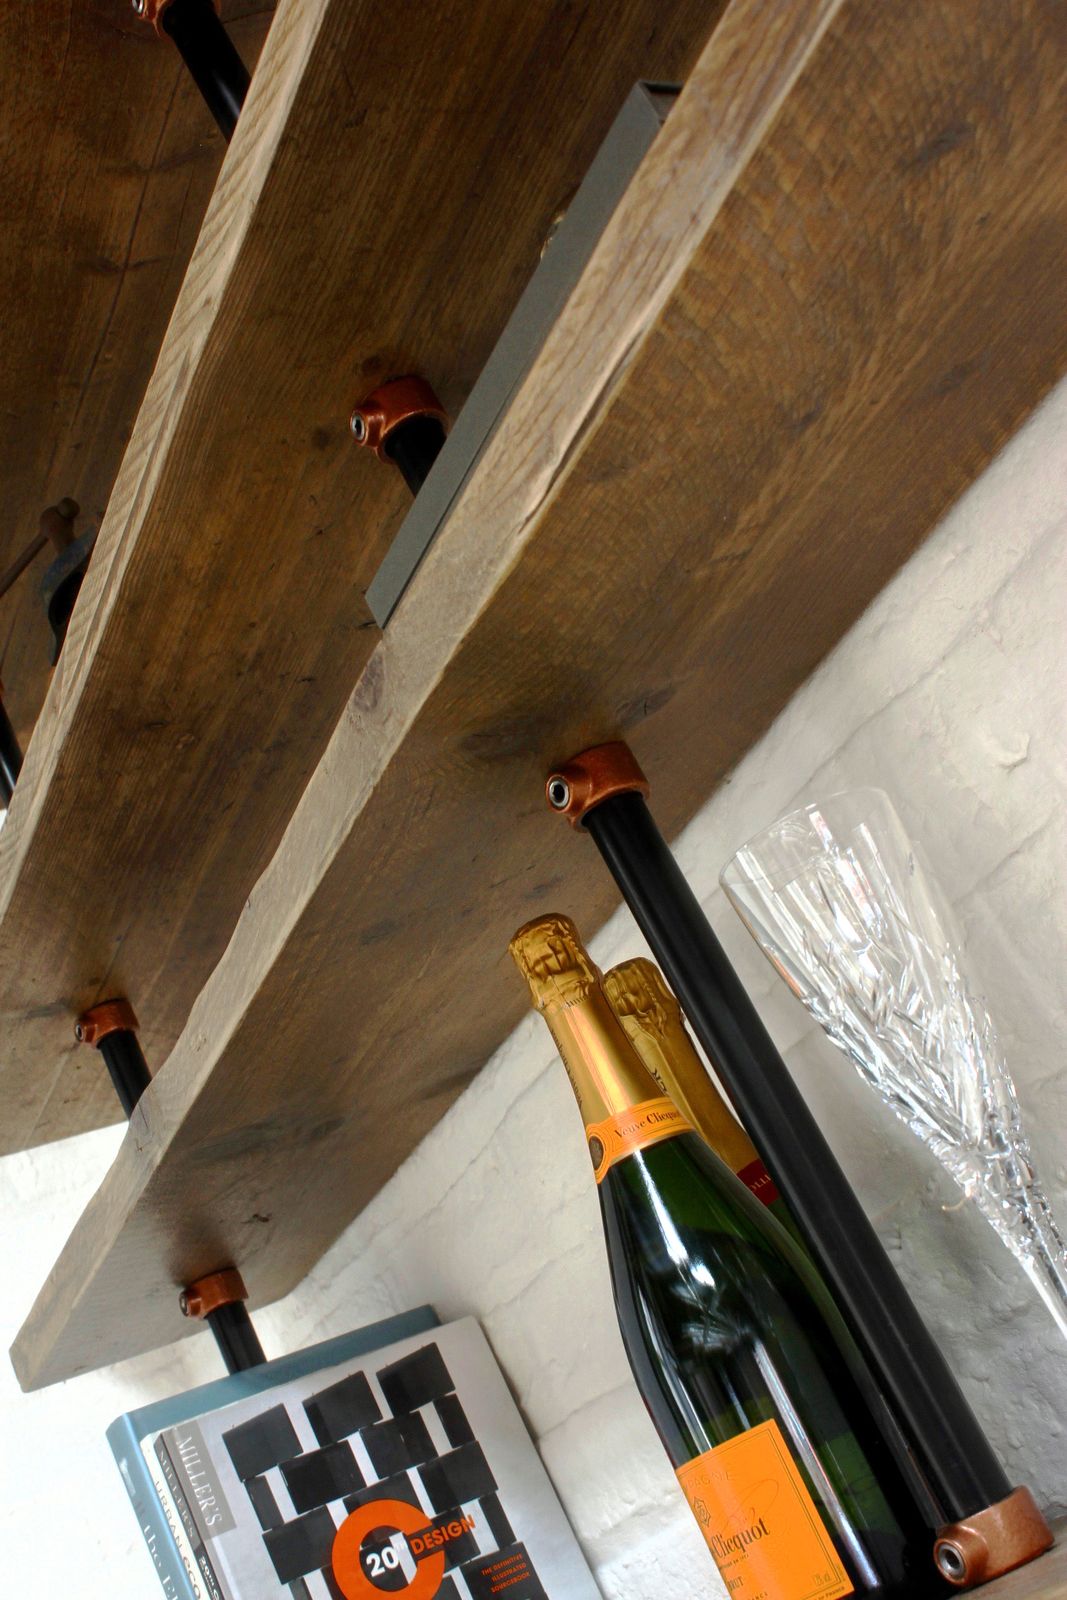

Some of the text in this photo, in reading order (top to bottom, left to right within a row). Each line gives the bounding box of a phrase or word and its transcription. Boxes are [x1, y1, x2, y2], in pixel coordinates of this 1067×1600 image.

[614, 1121, 646, 1138] Veuve
[159, 1450, 195, 1538] MILLER'S
[176, 1436, 223, 1526] MILLER'S
[155, 1480, 183, 1549] URBAN
[409, 1514, 476, 1555] DESIGN
[711, 1517, 770, 1559] Clicquot
